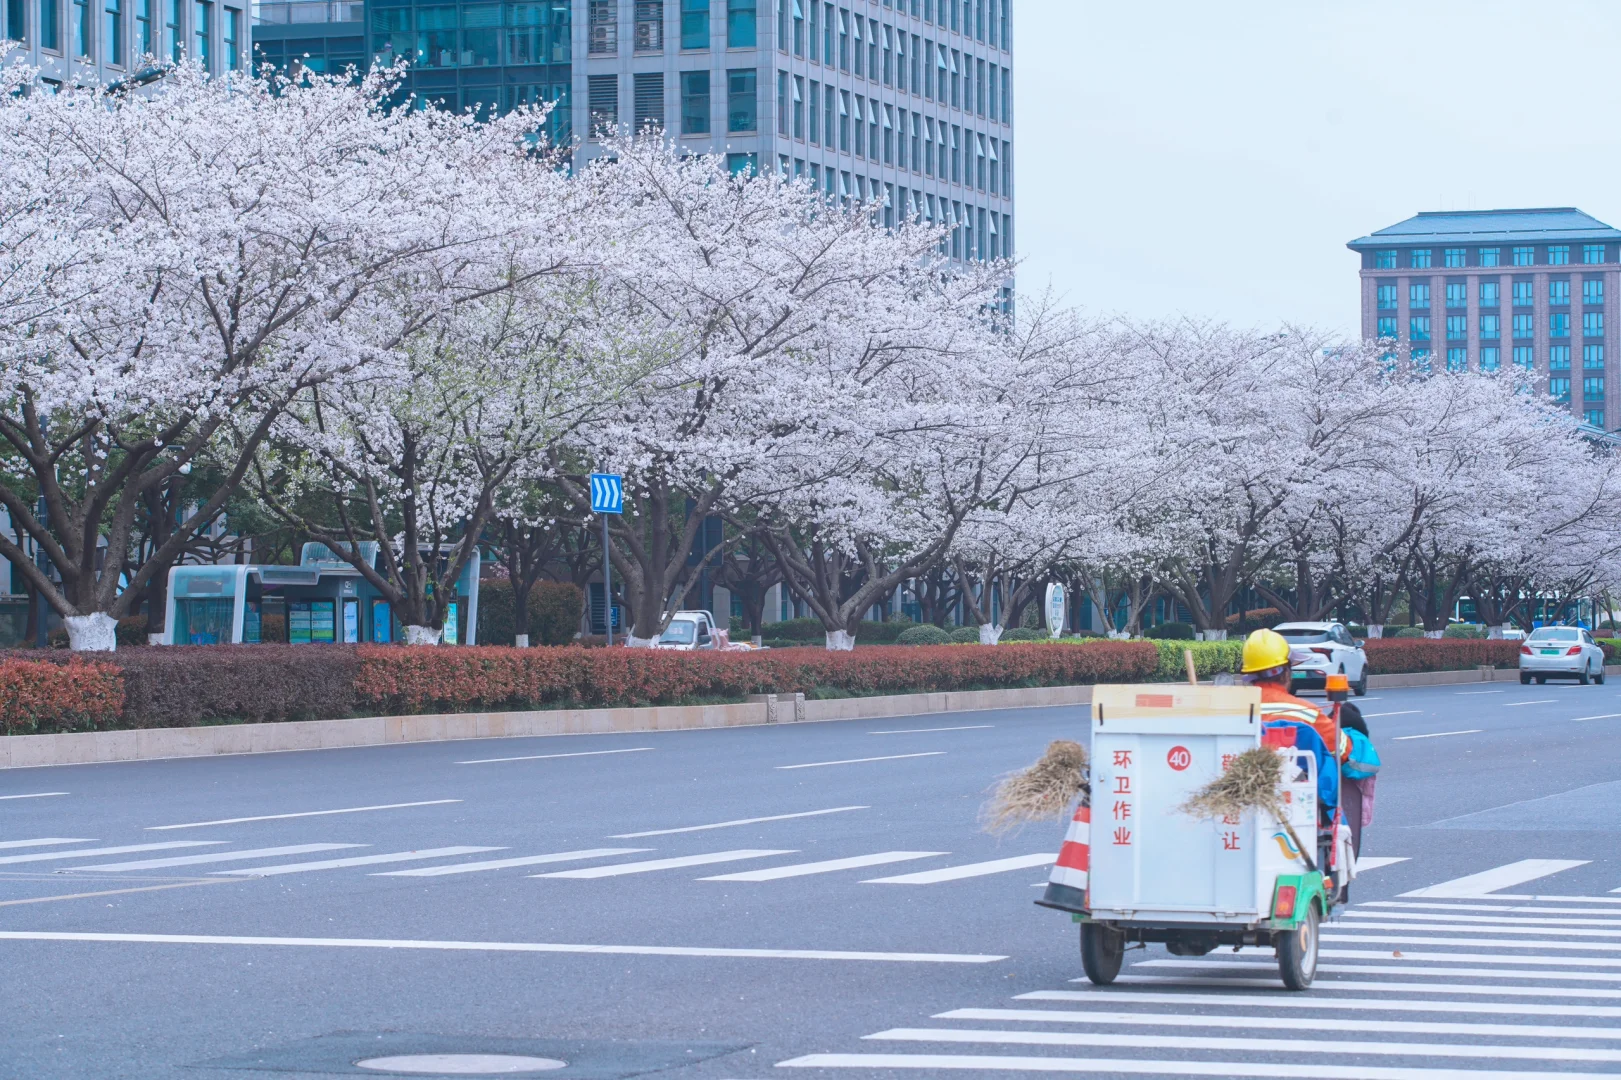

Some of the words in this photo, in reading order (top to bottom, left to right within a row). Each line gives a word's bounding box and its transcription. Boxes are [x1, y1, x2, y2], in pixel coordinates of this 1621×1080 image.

[1168, 751, 1189, 767] 40
[1112, 750, 1133, 846] 环卫作业
